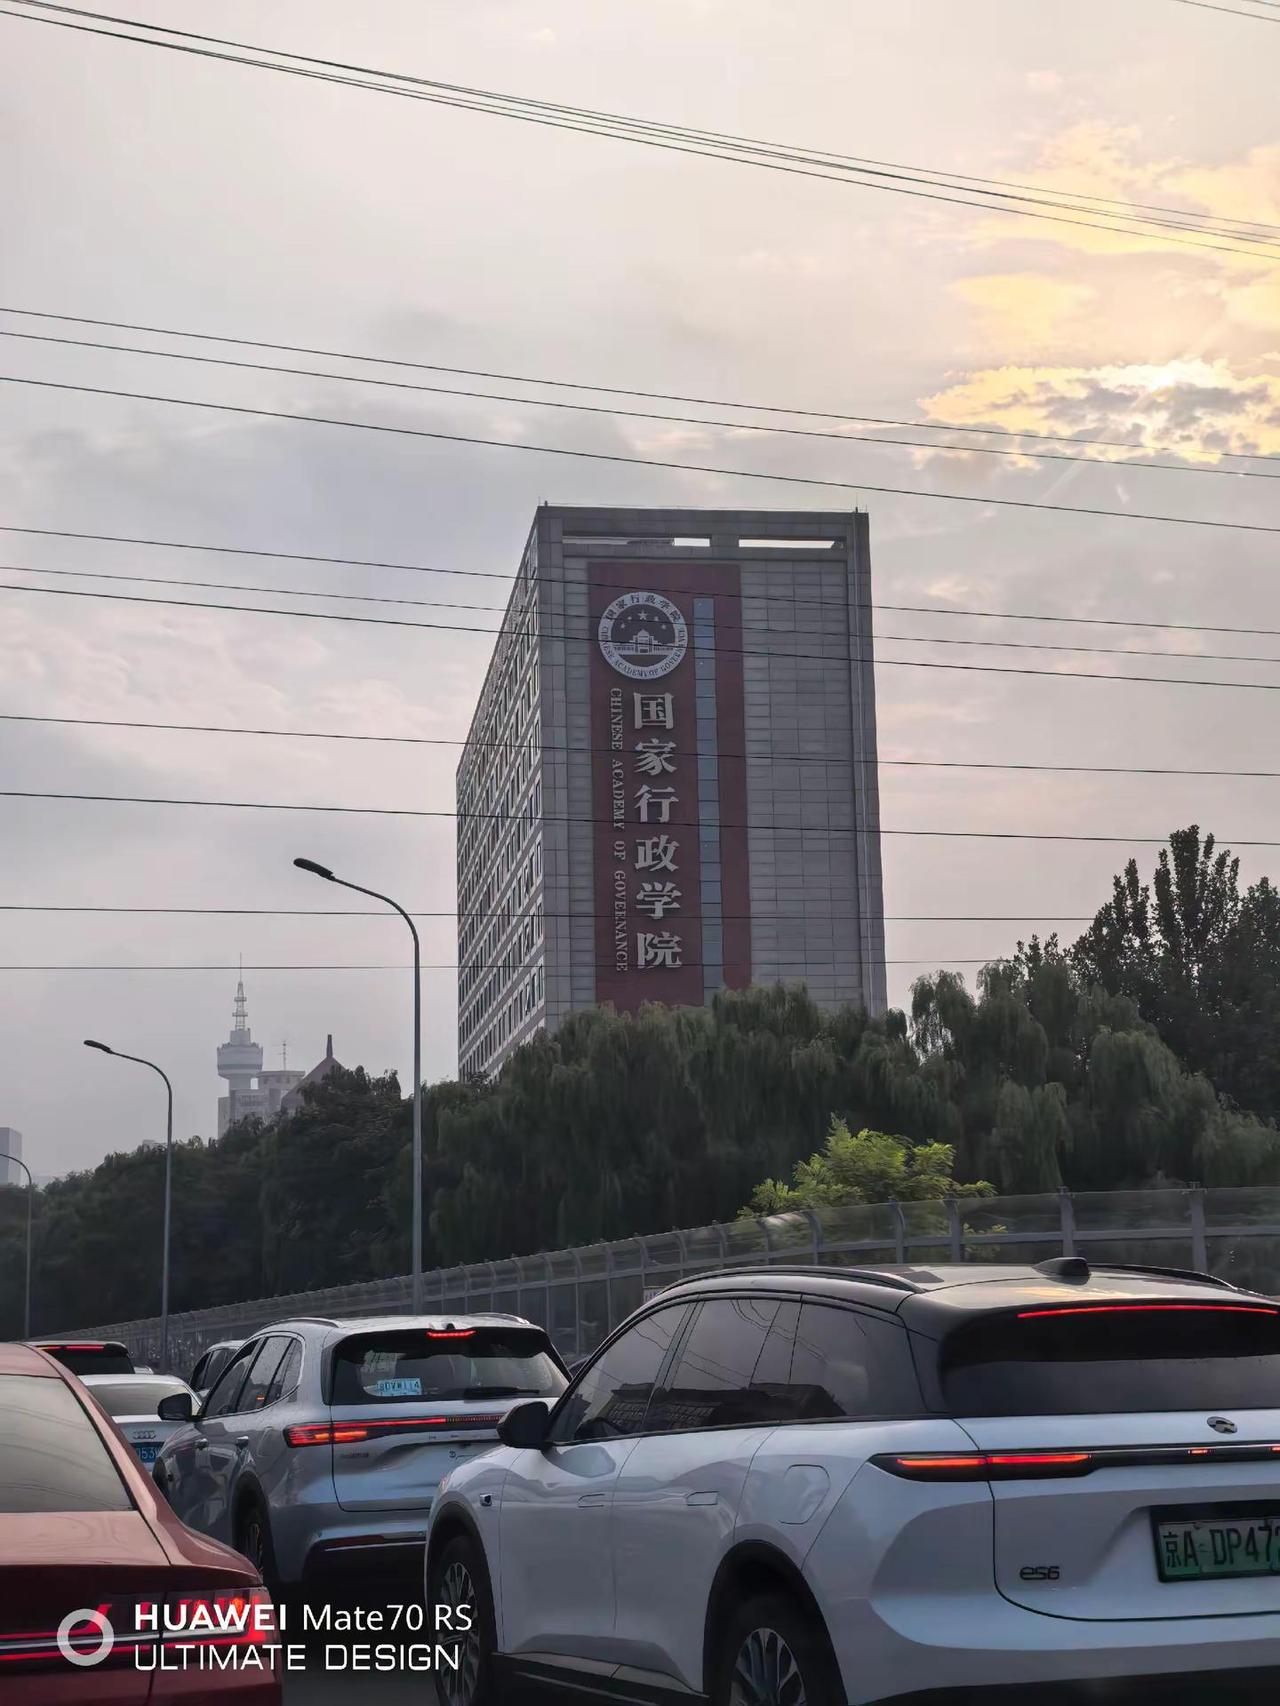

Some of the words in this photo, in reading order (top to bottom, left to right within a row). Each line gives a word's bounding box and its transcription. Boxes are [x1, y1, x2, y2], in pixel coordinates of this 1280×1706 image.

[610, 687, 624, 750] CHINESE
[612, 759, 626, 829] ACADEMY
[613, 840, 626, 861] OF
[633, 691, 683, 970] 国家行政学院
[613, 870, 629, 972] GOVERNANCE
